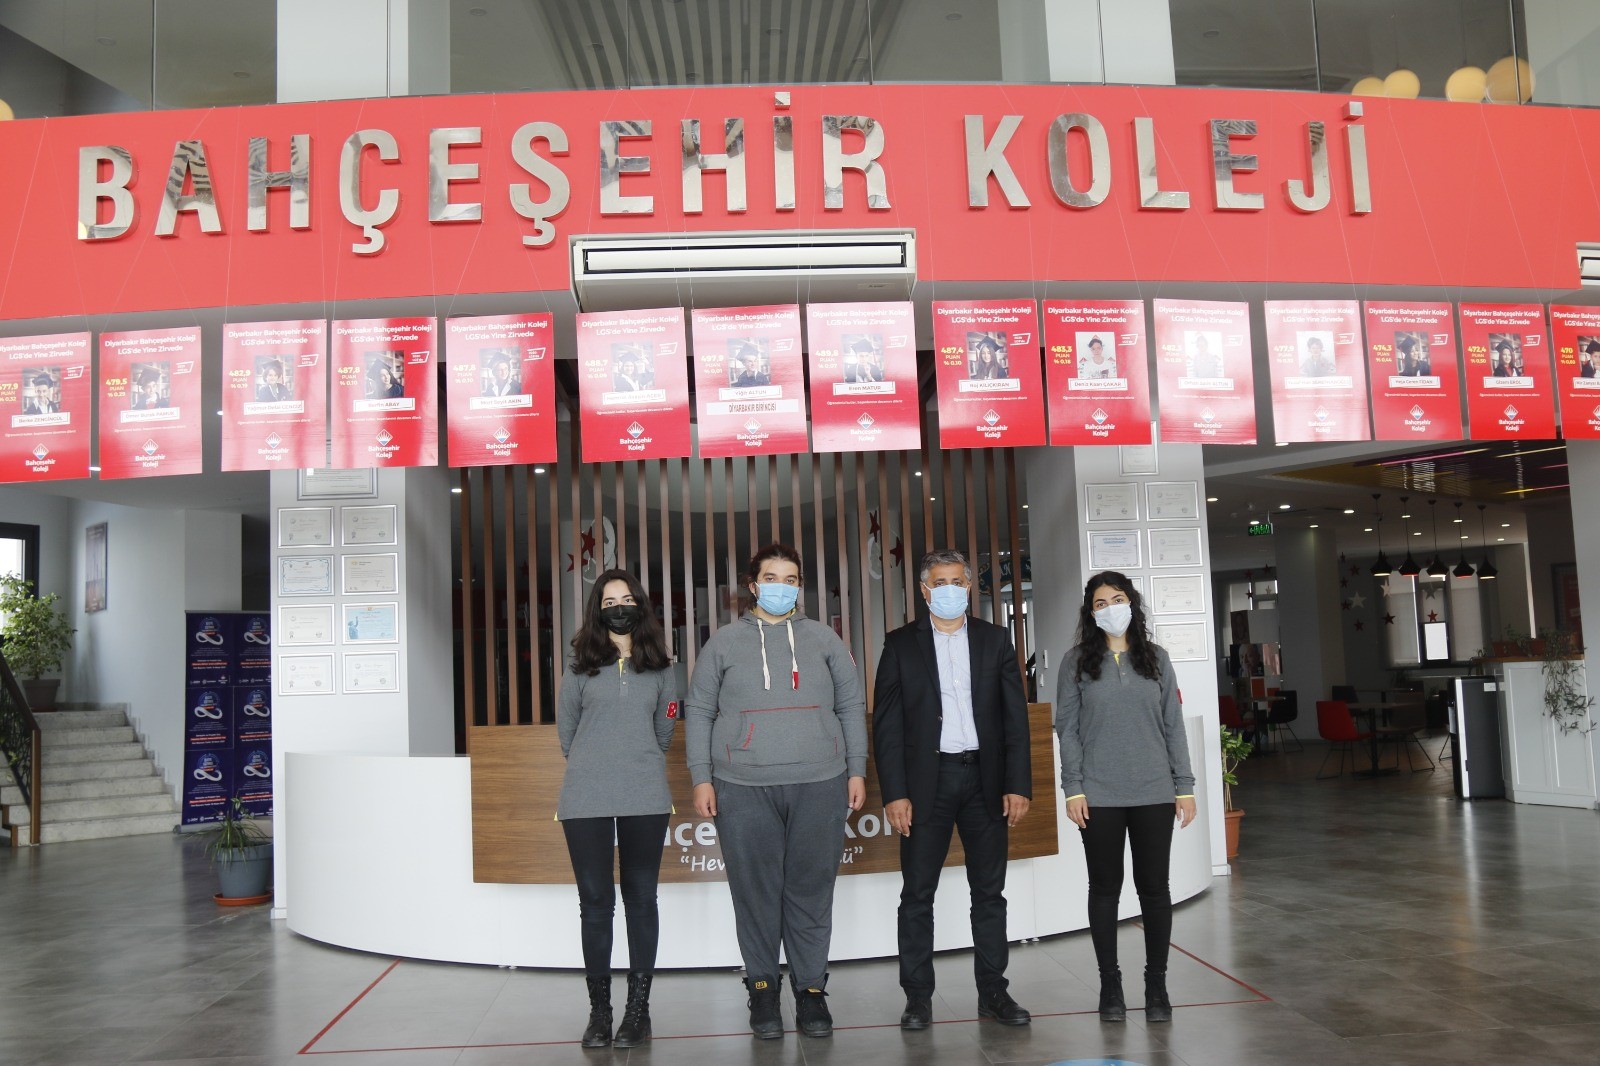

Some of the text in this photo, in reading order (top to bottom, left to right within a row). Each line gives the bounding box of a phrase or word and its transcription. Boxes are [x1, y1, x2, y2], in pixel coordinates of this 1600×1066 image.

[76, 90, 1373, 257] BAHÇEŞEHİR KOLEJİ
[619, 317, 658, 325] Bahçeşehir
[735, 313, 773, 322] Bahçeşehir
[374, 326, 411, 334] Bahçeşehir
[488, 323, 526, 331] Bahçeşehir
[229, 330, 262, 338] Diyarbakır
[264, 328, 301, 336] Bahçeşehir
[140, 336, 176, 345] Bahçeşehir
[32, 340, 86, 350] Bahçeşehir Koleji
[229, 369, 251, 377] 482,9
[729, 403, 755, 413] DİYARBAKIR
[620, 437, 652, 445] Bahçeşehir
[736, 433, 769, 441] Bahçeşehir
[486, 442, 518, 450] Bahçeşehir
